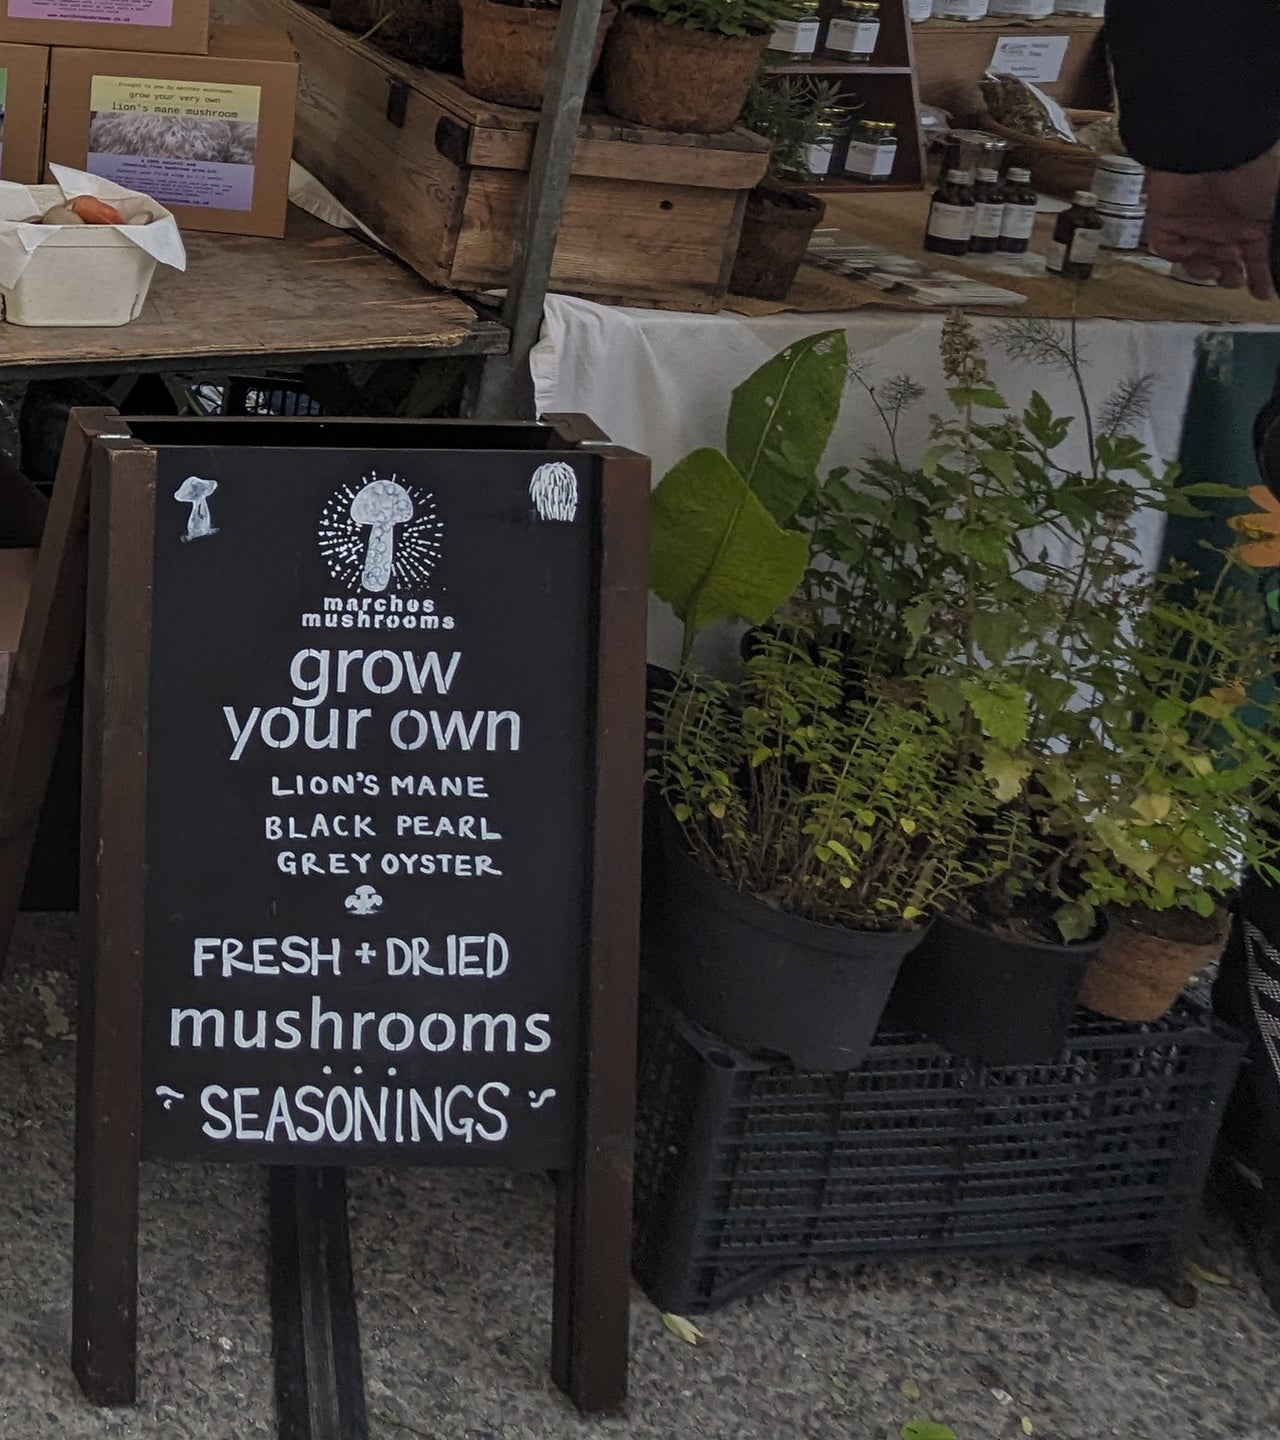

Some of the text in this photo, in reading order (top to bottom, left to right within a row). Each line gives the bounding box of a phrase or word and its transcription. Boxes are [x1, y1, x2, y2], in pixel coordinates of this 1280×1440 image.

[129, 91, 150, 99] grow
[112, 102, 238, 118] lion's mane mushroom
[302, 612, 456, 631] mushrooms
[289, 648, 462, 708] grow
[222, 706, 521, 761] your own
[271, 772, 489, 799] LION'S MANE
[265, 813, 502, 840] BLACK PEARL
[276, 851, 503, 877] GREY OYSTER
[193, 934, 342, 978] FRESH
[386, 932, 510, 978] DRIED
[170, 995, 551, 1053] mushrooms
[199, 1081, 511, 1143] SEASONINGS
